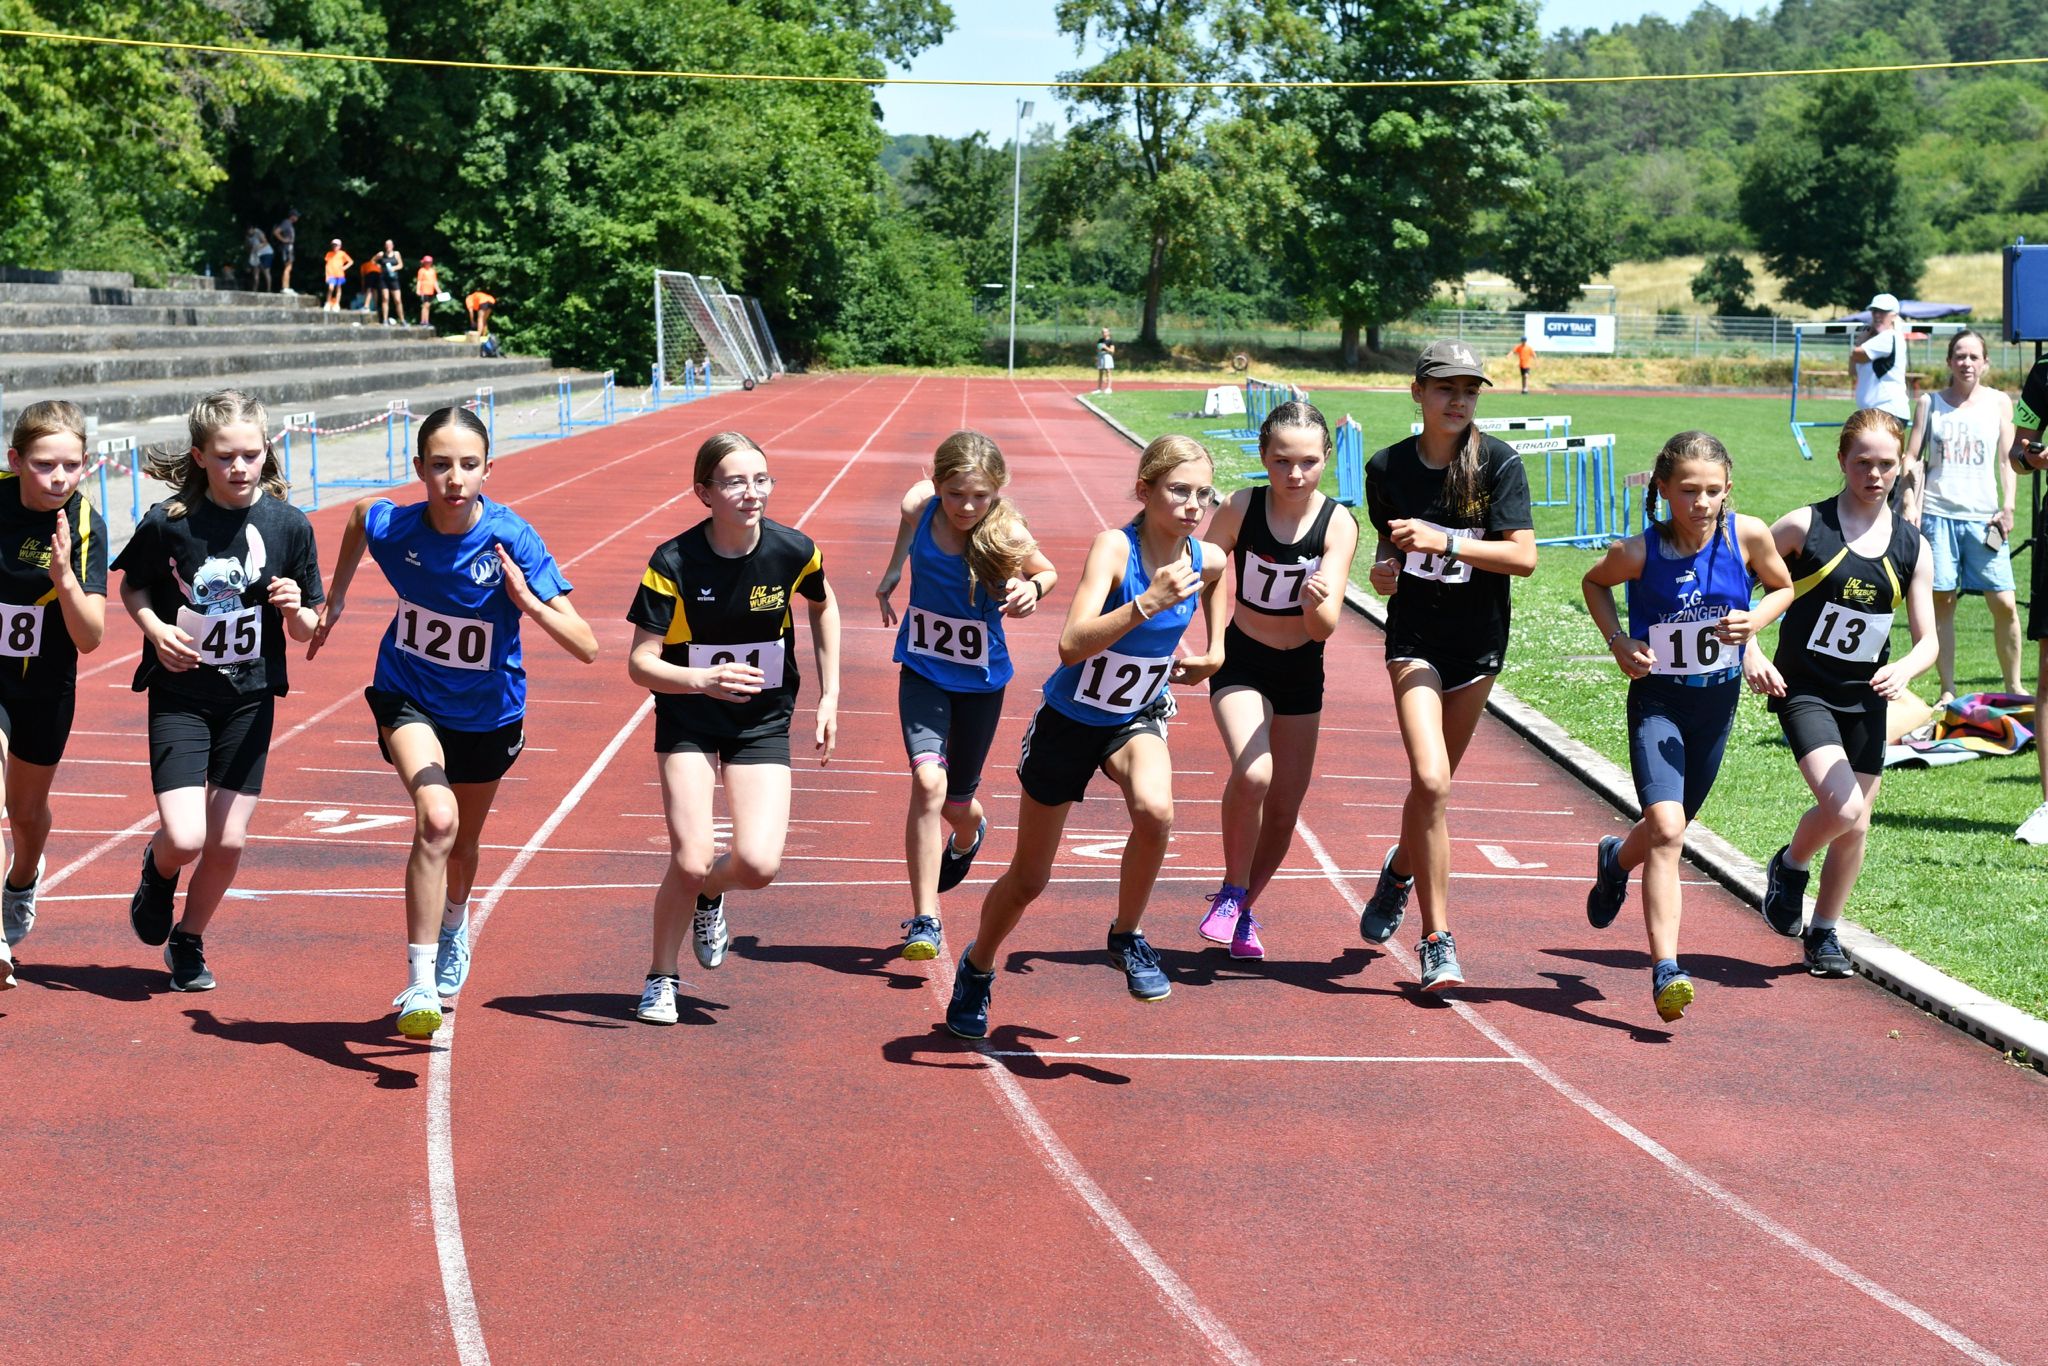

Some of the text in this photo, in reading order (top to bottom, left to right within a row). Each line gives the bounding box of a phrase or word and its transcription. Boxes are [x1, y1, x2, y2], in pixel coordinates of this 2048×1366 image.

[1547, 322, 1593, 332] CITY TALK
[1450, 344, 1476, 366] LA
[749, 585, 767, 600] LAZ
[1257, 564, 1307, 603] 77
[1844, 577, 1862, 589] LAZ
[0, 611, 36, 652] 8
[202, 613, 256, 659] 45
[402, 609, 486, 664] 120
[913, 612, 983, 660] 129
[1669, 626, 1720, 669] 16
[1813, 611, 1867, 655] 13
[1082, 655, 1169, 708] 127
[303, 809, 414, 834] 4
